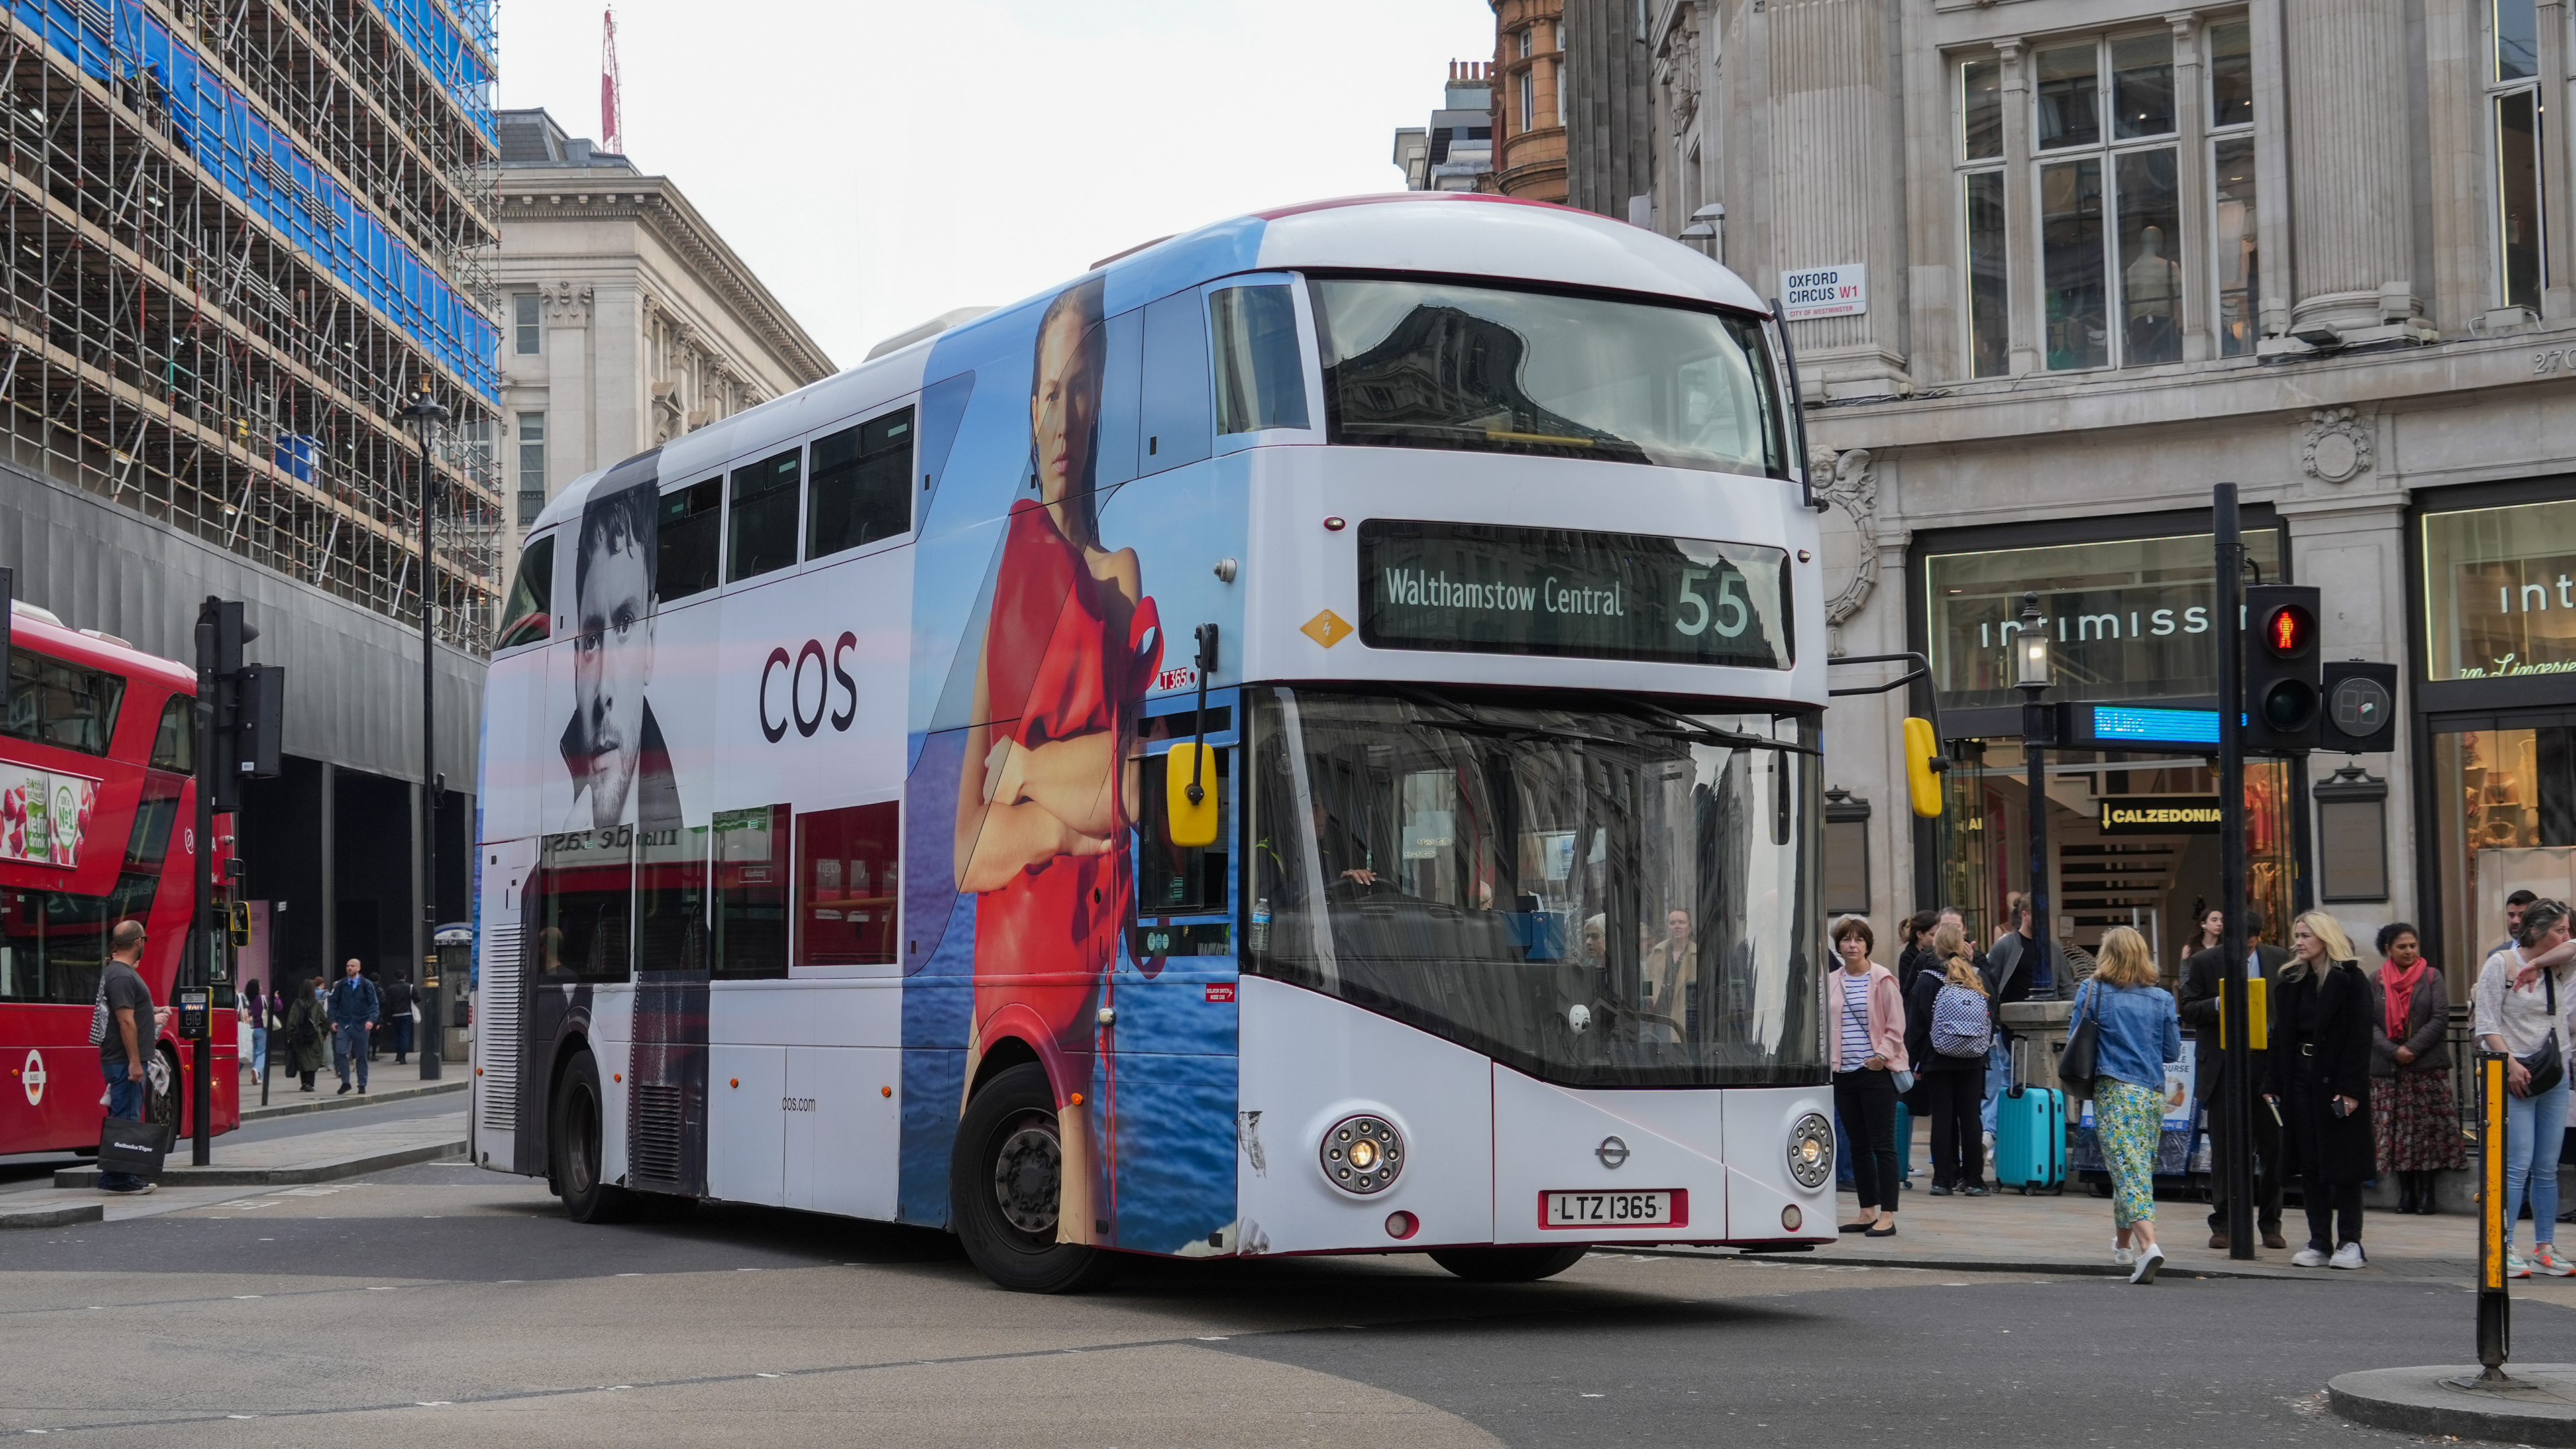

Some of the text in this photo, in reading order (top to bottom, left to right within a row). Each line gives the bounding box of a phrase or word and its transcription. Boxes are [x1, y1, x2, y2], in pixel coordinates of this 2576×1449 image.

[1789, 272, 1838, 288] OXFORD
[1789, 285, 1858, 303] CIRCUS W1
[1813, 305, 1853, 315] WESTMINSTER
[1386, 568, 1748, 637] Walthamstow Central 55
[759, 631, 857, 743] COS
[2112, 808, 2222, 823] CALZEDONIA
[29, 833, 46, 849] drink
[782, 1097, 816, 1112] cos.com
[114, 1142, 138, 1150] Onitsuka
[1561, 1195, 1656, 1220] LTZ 1365
